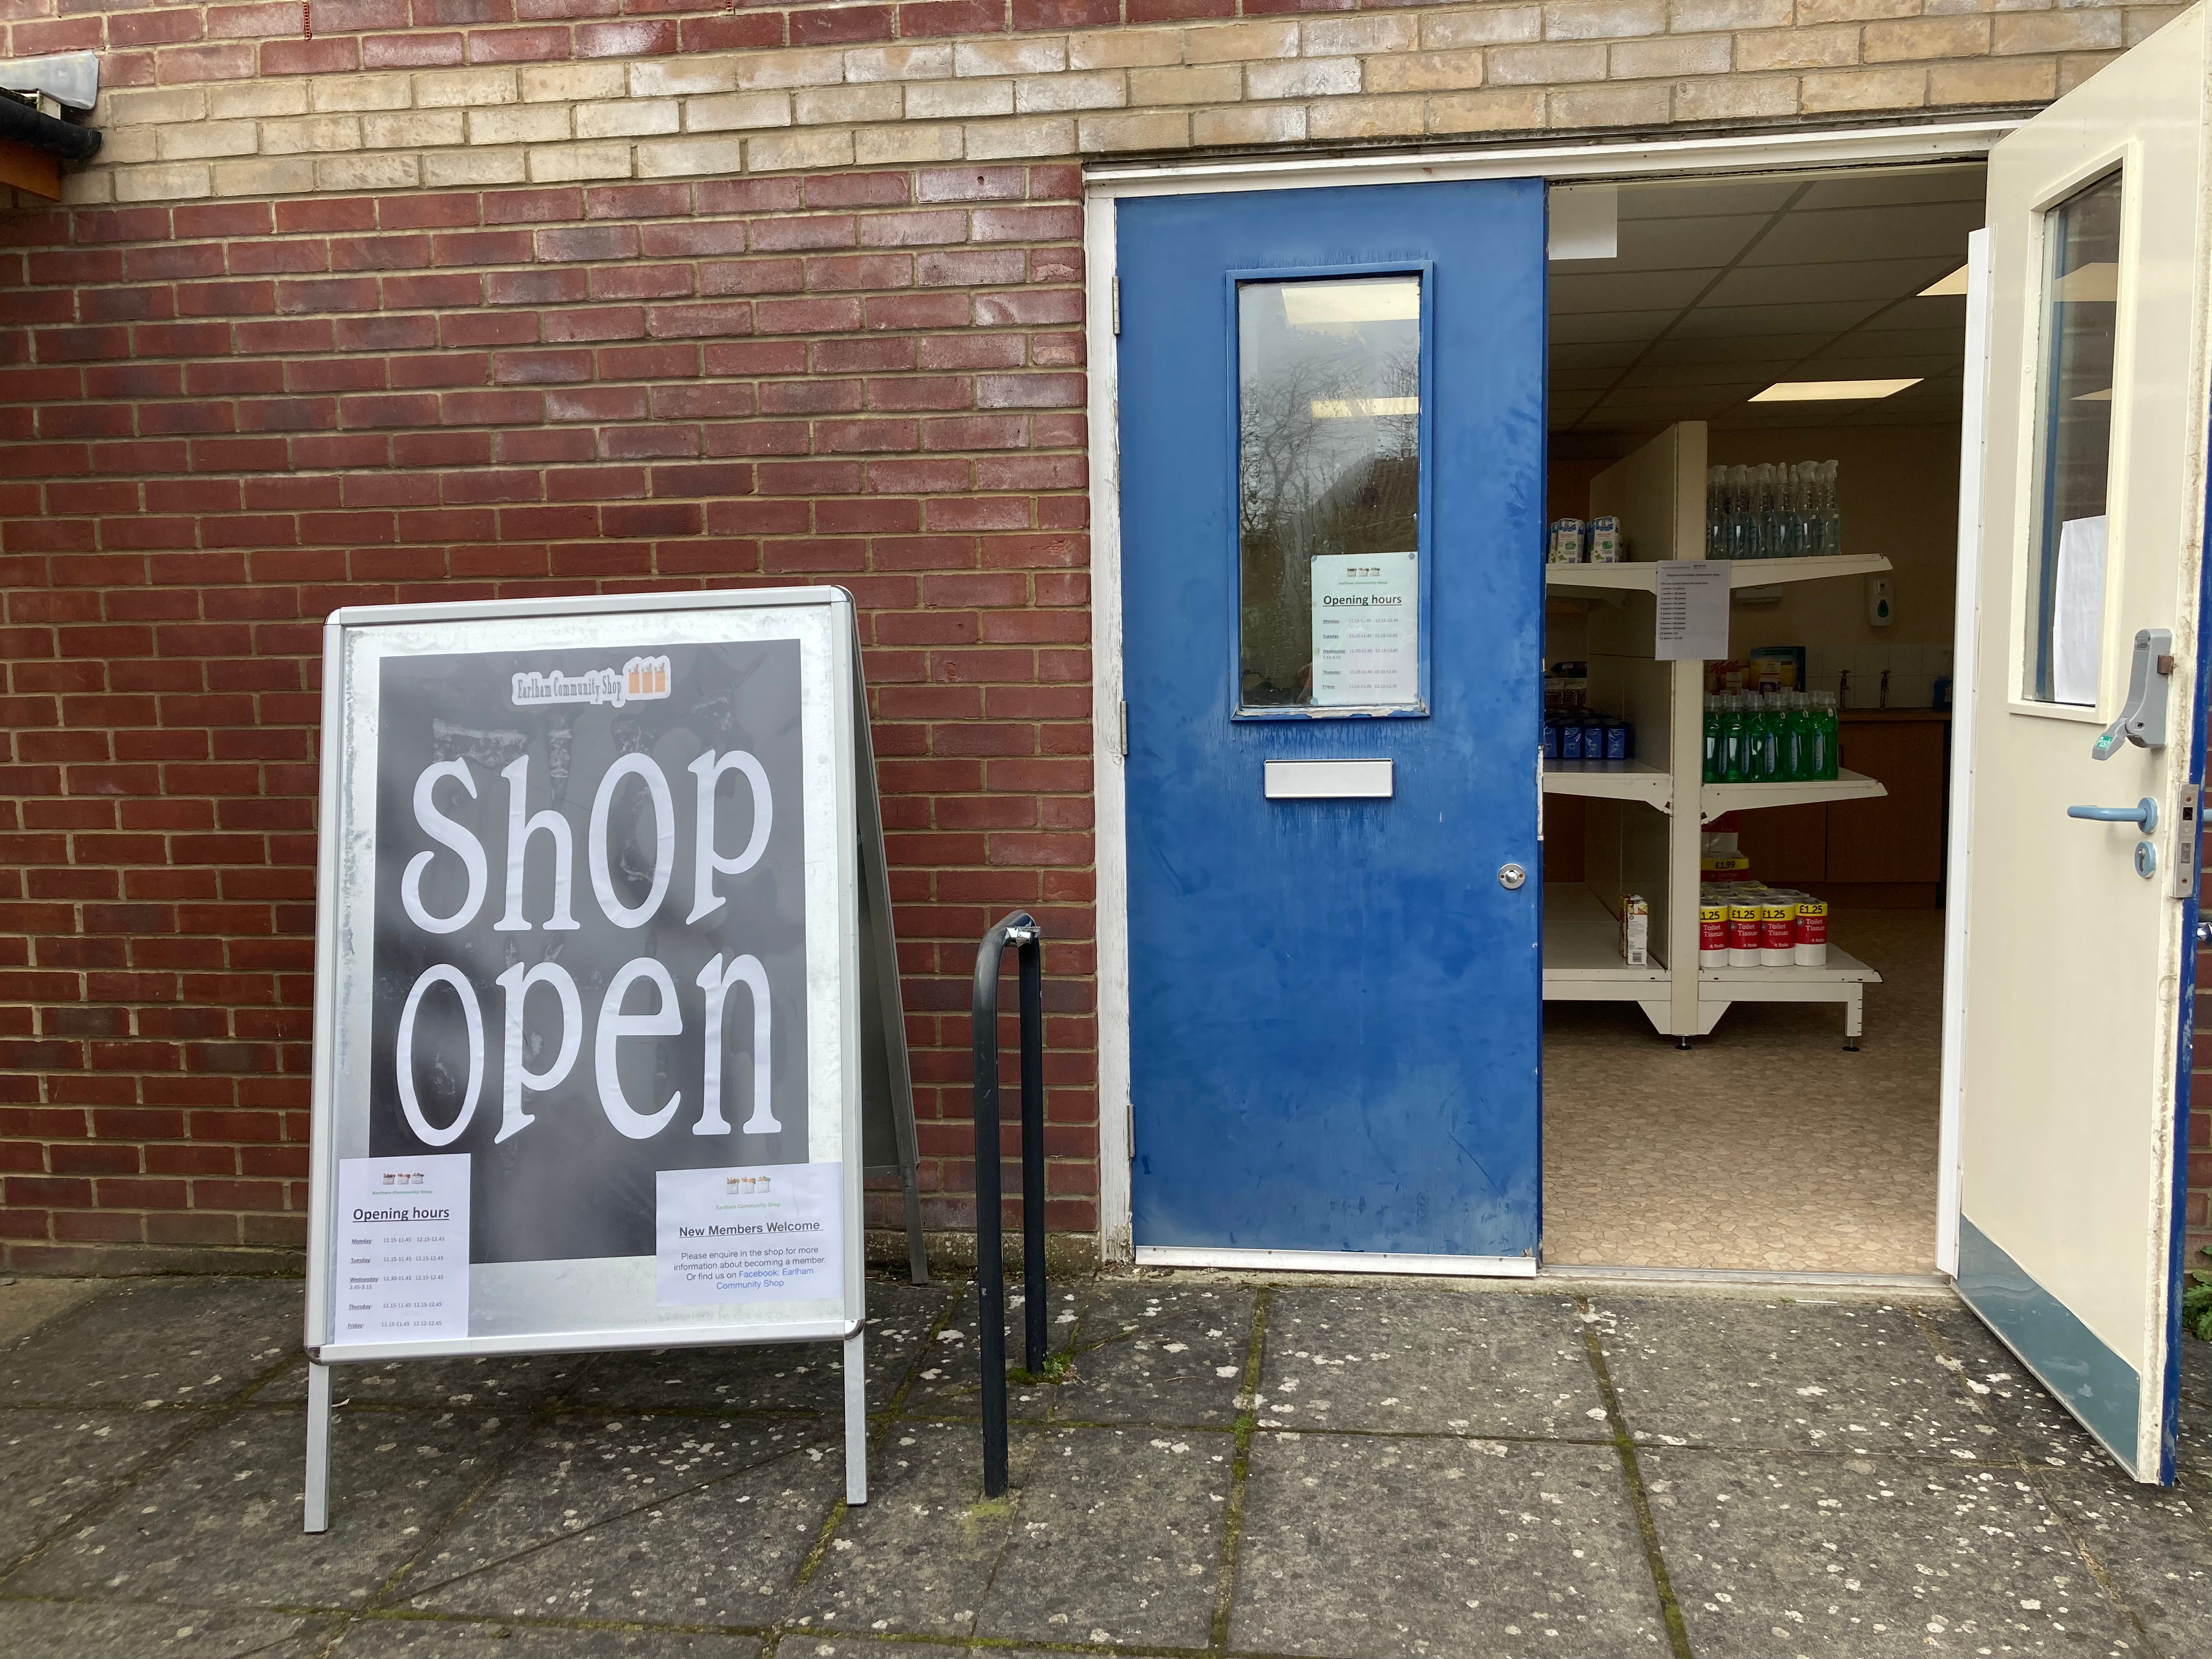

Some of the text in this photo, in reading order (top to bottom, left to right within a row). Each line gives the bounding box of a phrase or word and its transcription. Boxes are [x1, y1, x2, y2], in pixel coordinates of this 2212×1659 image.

[1323, 595, 1402, 606] Opening hours
[518, 675, 622, 702] Earlham Community Shop
[2095, 737, 2111, 748] Push
[1732, 910, 1754, 919] £1.25
[1763, 910, 1785, 918] £1.25
[1799, 905, 1822, 914] £1.25
[1700, 911, 1720, 920] 1.25
[353, 1207, 449, 1221] Opening hours
[679, 1221, 820, 1237] New Members Welcome
[681, 1251, 707, 1260] Please
[709, 1250, 738, 1260] enquire
[764, 1248, 783, 1257] shop
[674, 1261, 718, 1271] information
[720, 1261, 742, 1269] about
[744, 1259, 783, 1269] becoming
[792, 1256, 826, 1265] member.
[698, 1272, 713, 1280] find
[739, 1268, 779, 1278] Facebook:
[716, 1279, 784, 1289] Community Shop
